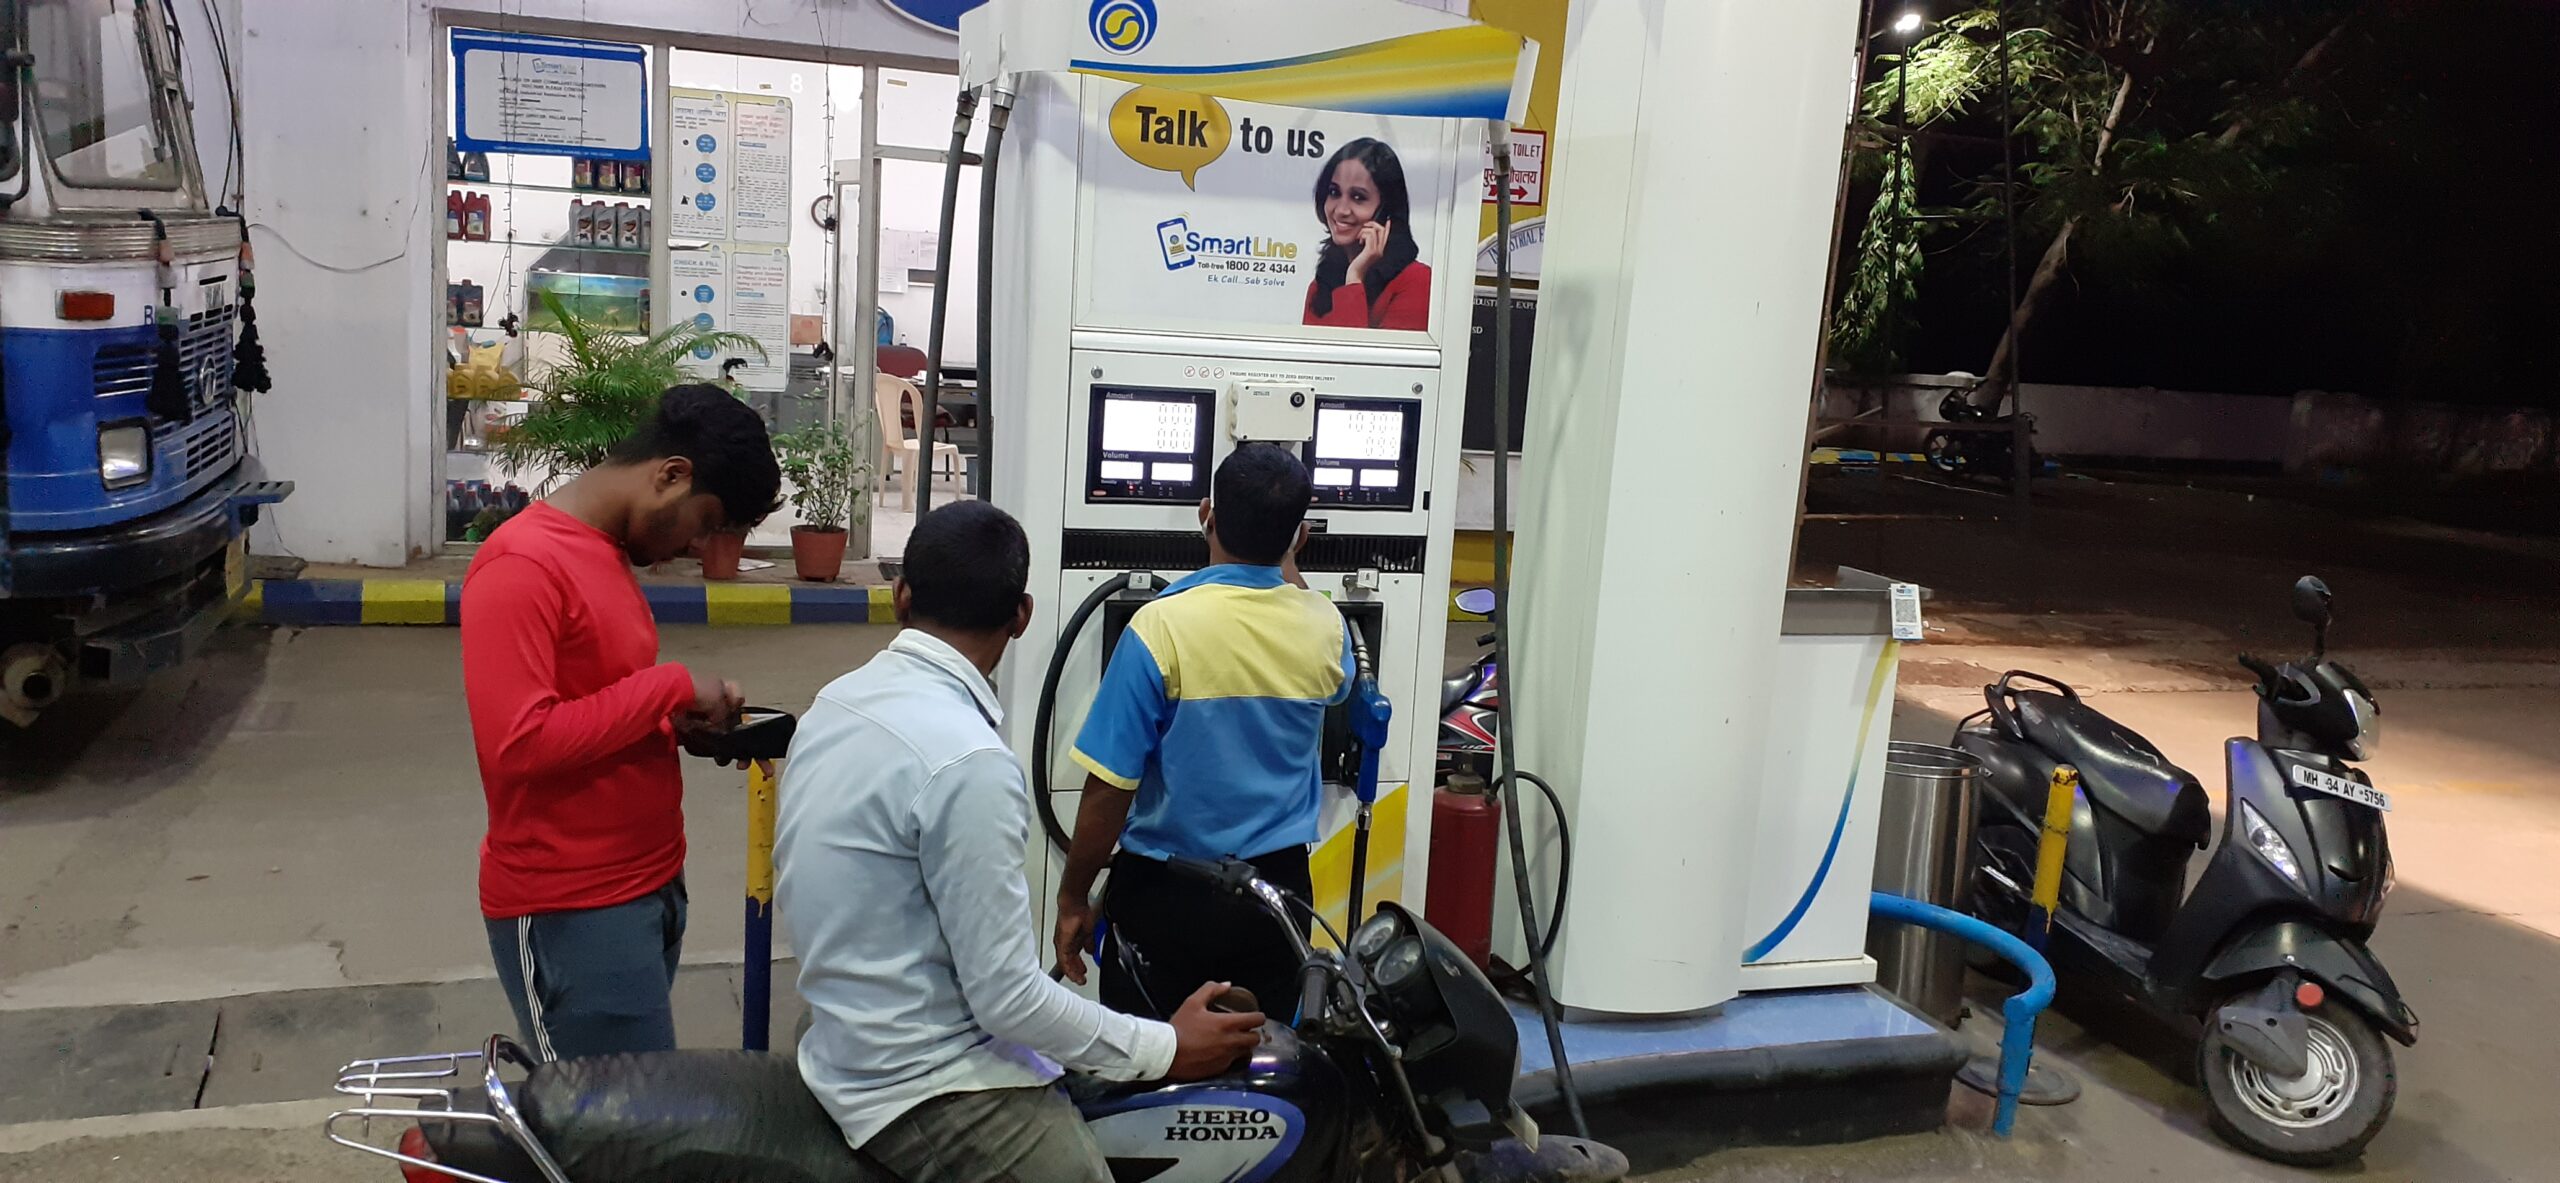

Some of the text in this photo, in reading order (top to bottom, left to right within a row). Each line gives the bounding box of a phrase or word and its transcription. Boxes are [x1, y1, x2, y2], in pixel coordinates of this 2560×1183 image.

[1135, 105, 1325, 158] Talk to us
[1513, 143, 1541, 157] TOILET
[1186, 232, 1297, 259] SmartLine
[1225, 260, 1250, 272] 1800
[1253, 262, 1266, 273] 22
[1269, 262, 1296, 274] 4344
[1207, 274, 1219, 282] Ek
[1263, 278, 1285, 287] Solve
[1106, 391, 1134, 400] Amount
[1320, 401, 1345, 409] Amount
[1102, 451, 1129, 459] Volume
[1315, 458, 1340, 466] Volume
[2303, 770, 2319, 787] MH
[2343, 783, 2355, 798] AY
[2364, 789, 2385, 807] 5756
[1177, 1109, 1270, 1124] HERO
[1165, 1126, 1279, 1141] HONDA
